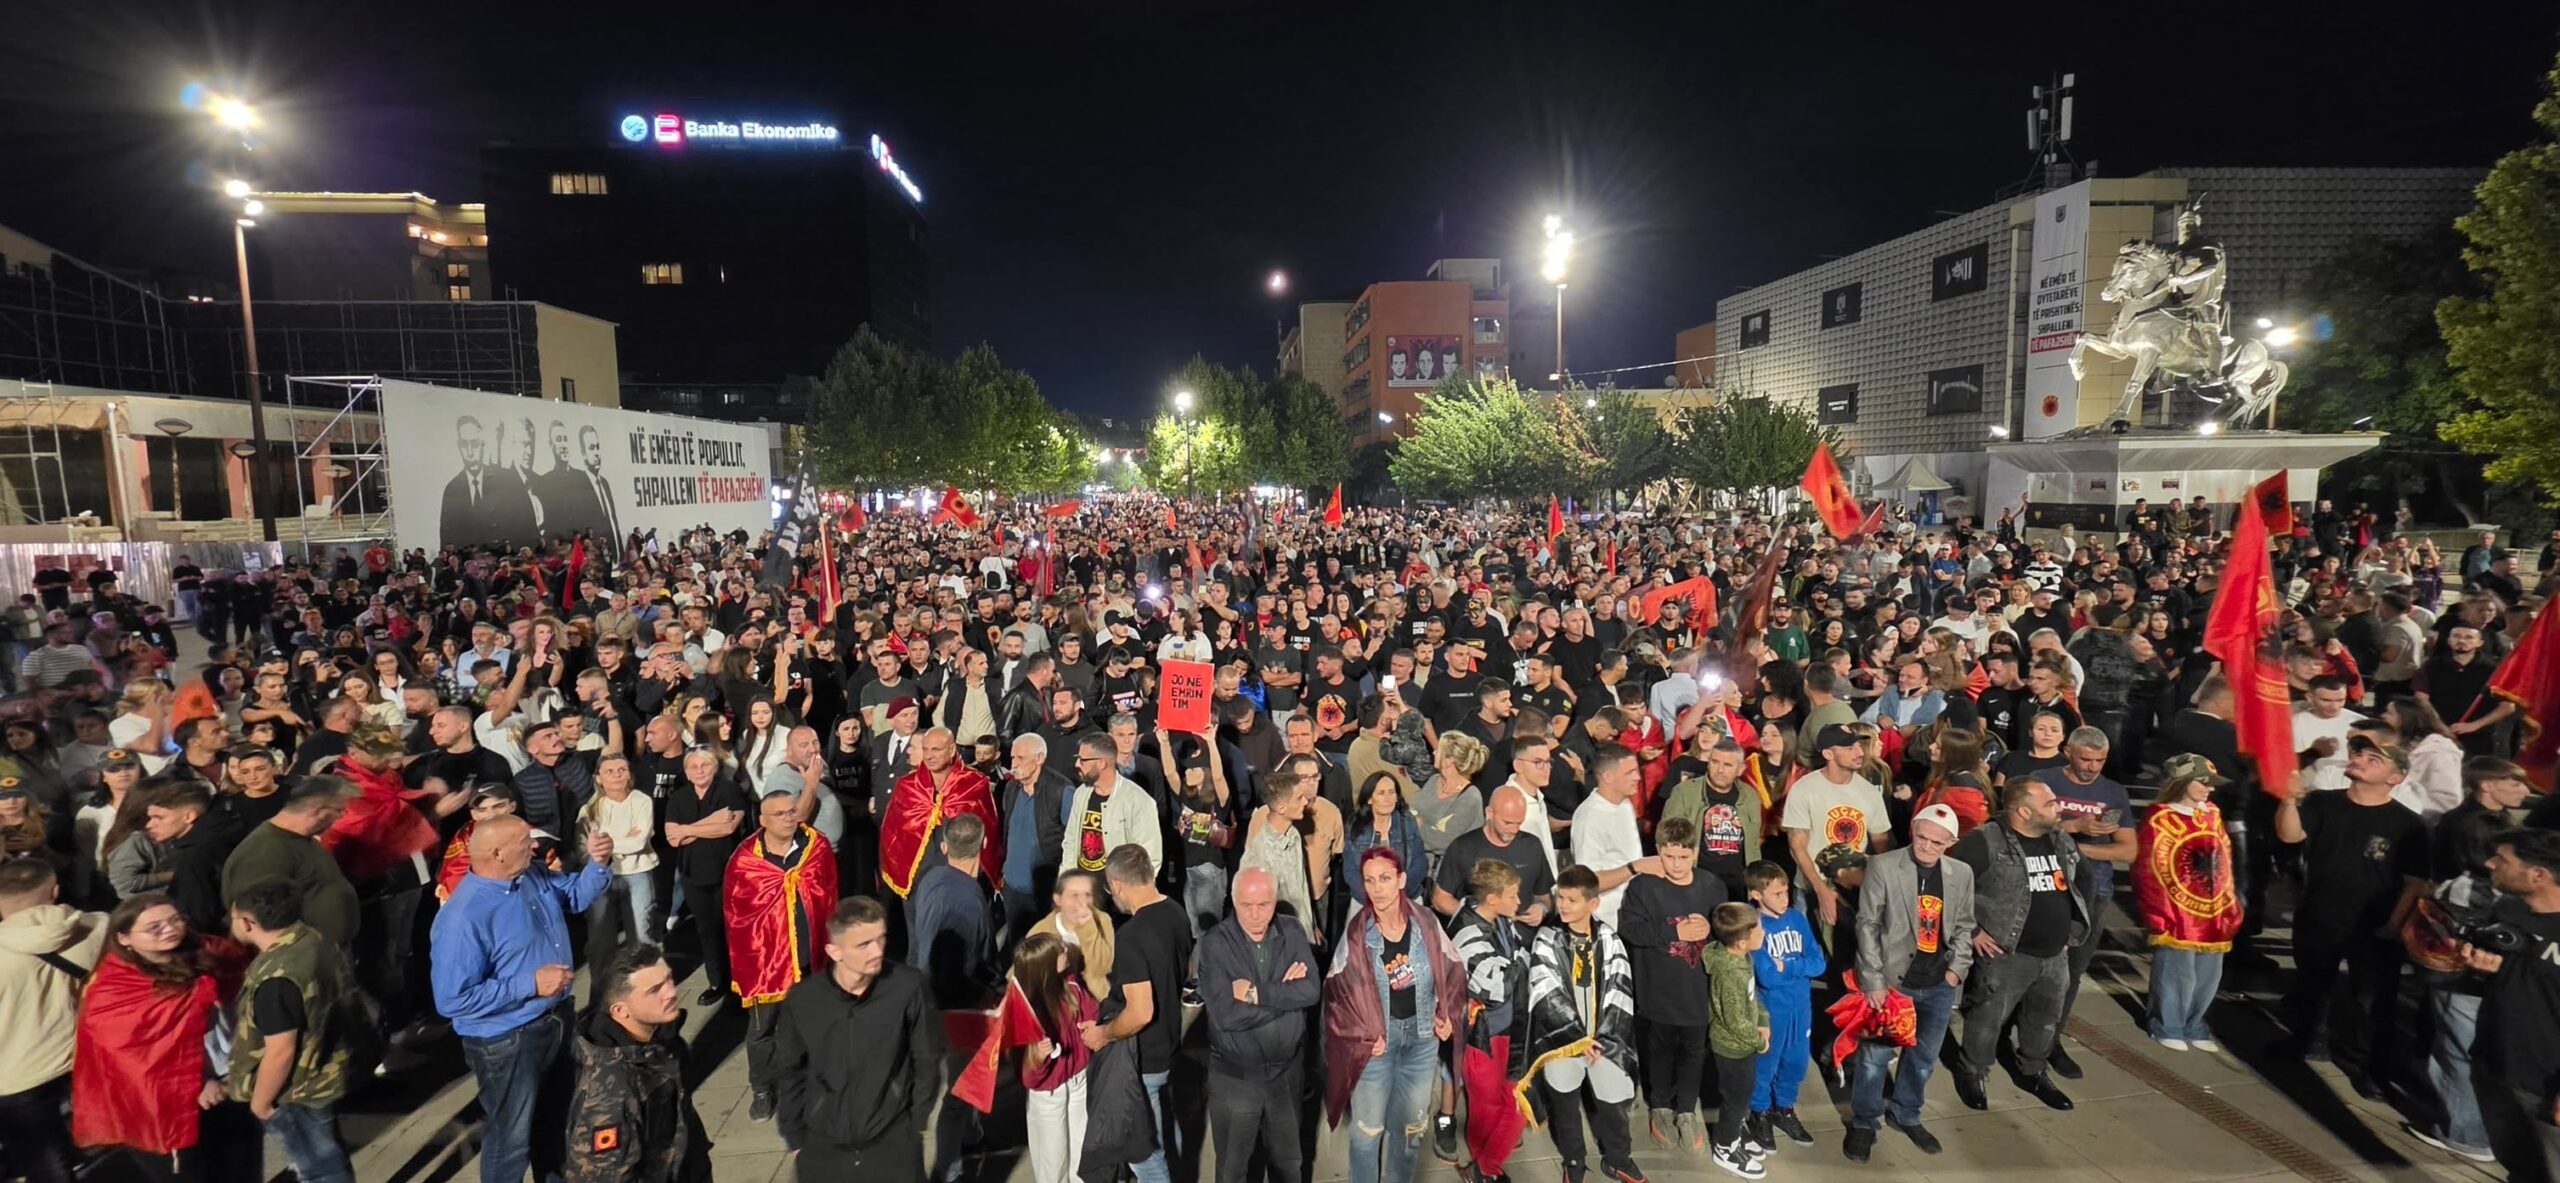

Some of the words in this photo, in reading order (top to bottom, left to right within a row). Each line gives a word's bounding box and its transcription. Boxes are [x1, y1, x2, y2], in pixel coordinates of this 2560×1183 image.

[685, 121, 739, 138] Banka
[742, 122, 838, 140] Ekonomike
[2068, 269, 2077, 282] TË
[2033, 307, 2040, 320] TË
[2037, 319, 2073, 335] SHPALLENI
[629, 426, 647, 464] NË
[648, 428, 681, 465] EMËR
[681, 431, 696, 465] TË
[698, 438, 746, 469] POPULLIT,
[633, 476, 697, 507] SHPALLENI
[697, 471, 711, 504] TË
[711, 472, 766, 504] PAFAJSHËM!
[1171, 674, 1184, 685] JO
[1171, 687, 1203, 699] EMRIN
[1171, 698, 1188, 709] TIM
[2025, 855, 2050, 873] IRIA
[2029, 873, 2056, 892] MËR
